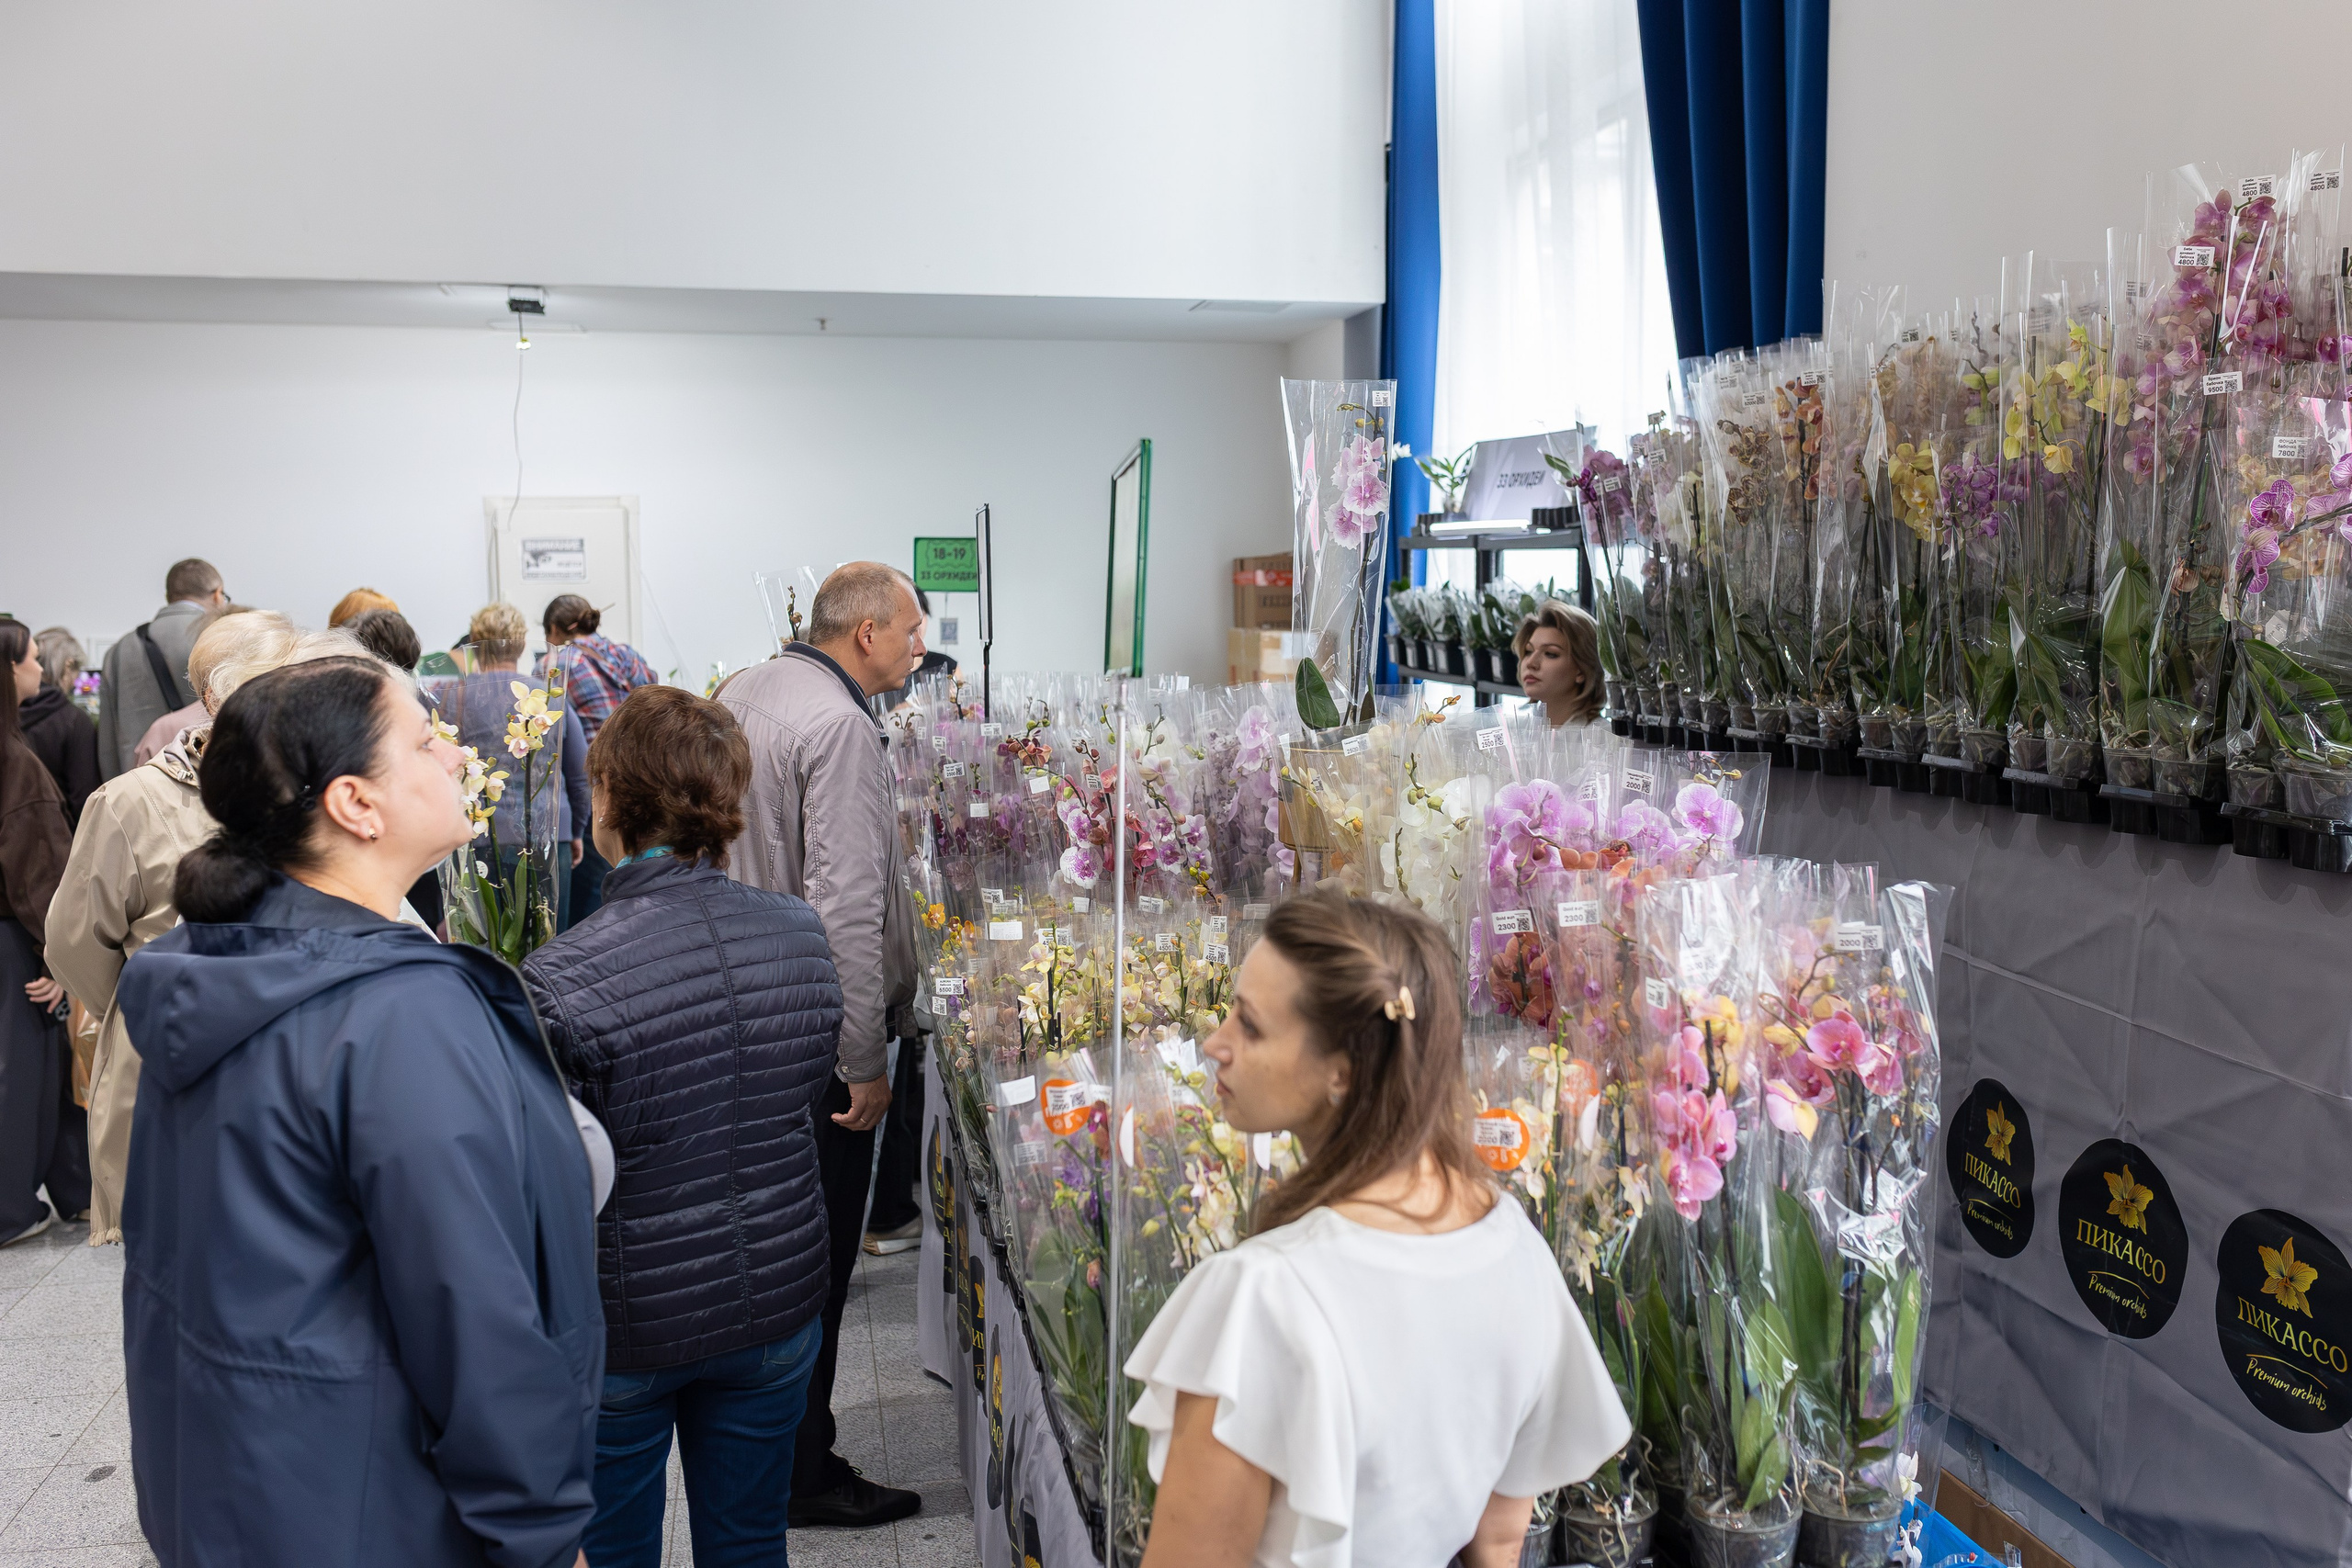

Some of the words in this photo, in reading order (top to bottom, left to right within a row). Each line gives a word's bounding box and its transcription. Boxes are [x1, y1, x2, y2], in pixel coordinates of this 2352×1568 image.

[1497, 473, 1508, 488] 33
[933, 547, 966, 559] 18-19
[1626, 781, 1640, 790] 2000
[1498, 922, 1516, 931] 2300
[1965, 1152, 2021, 1209] ПИКАССО
[1967, 1201, 1994, 1228] Premium
[1995, 1220, 2014, 1240] orchids
[2076, 1218, 2165, 1284] ПИКАССО
[2088, 1274, 2120, 1303] Premium
[2121, 1296, 2147, 1319] orchids
[2237, 1296, 2348, 1373] ПИКАССО
[2246, 1357, 2290, 1393] Premium
[2291, 1385, 2327, 1412] orchids
